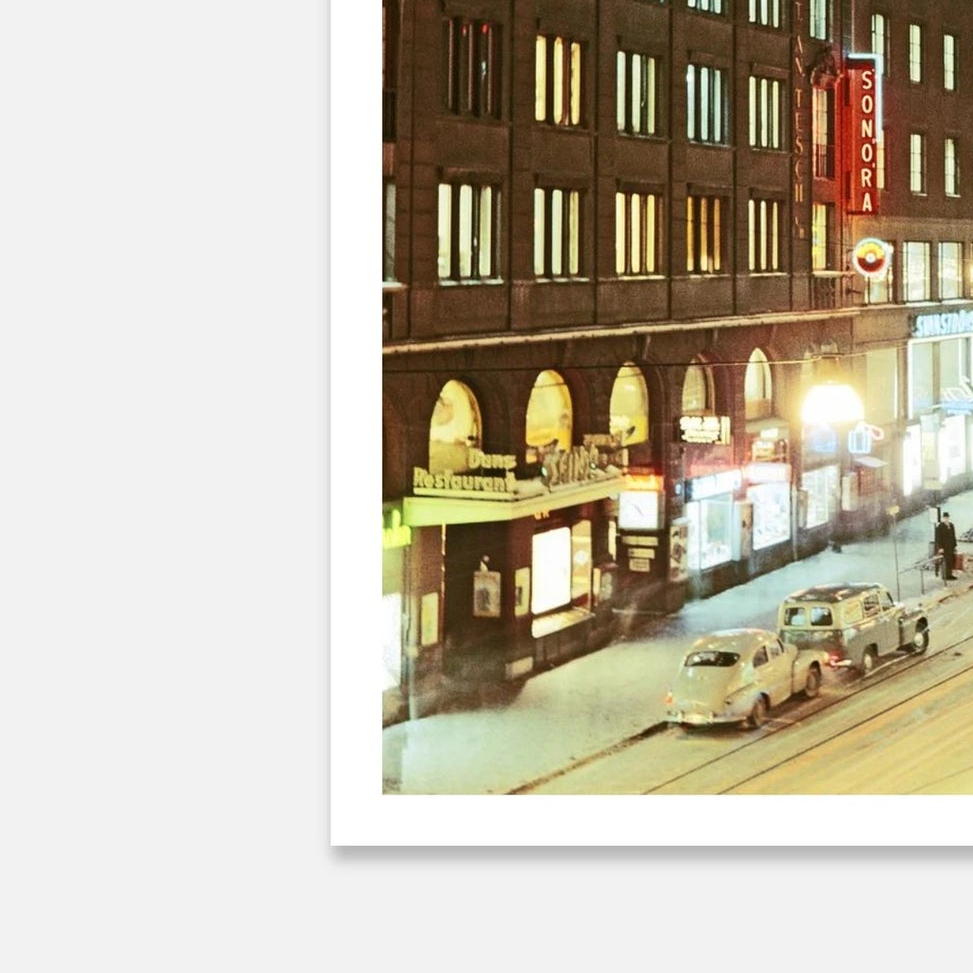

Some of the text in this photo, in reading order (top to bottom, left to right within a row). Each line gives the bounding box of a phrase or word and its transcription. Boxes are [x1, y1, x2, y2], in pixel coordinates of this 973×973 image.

[860, 70, 874, 213] SONORA
[468, 447, 517, 469] Dans
[413, 466, 517, 492] Restaurant
